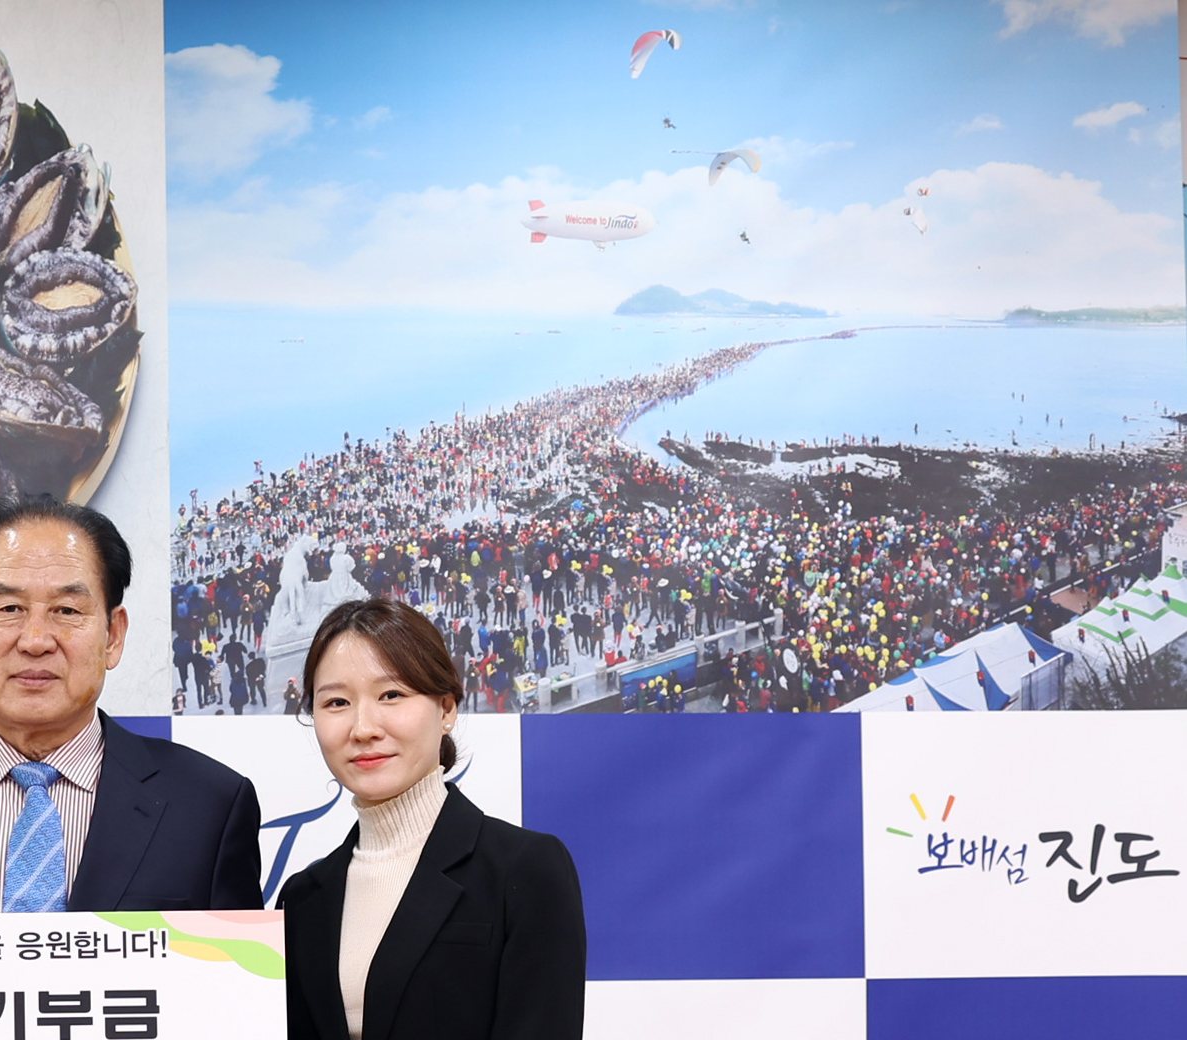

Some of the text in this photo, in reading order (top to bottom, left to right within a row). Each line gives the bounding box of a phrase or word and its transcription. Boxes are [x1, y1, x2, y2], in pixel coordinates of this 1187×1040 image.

[565, 215, 597, 225] Welcome
[600, 217, 607, 226] to
[605, 216, 633, 229] Jindo
[918, 823, 1180, 904] 보배섬 진도
[15, 930, 167, 961] 응원합니다!
